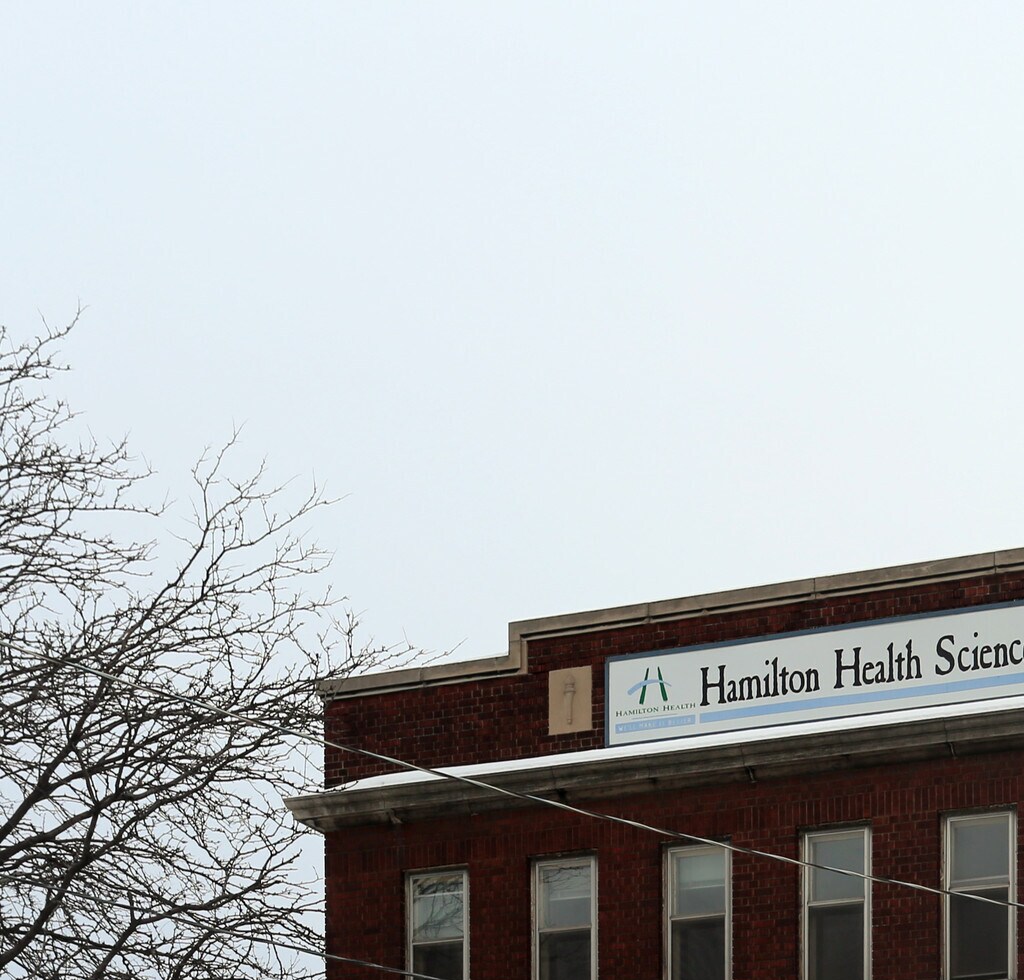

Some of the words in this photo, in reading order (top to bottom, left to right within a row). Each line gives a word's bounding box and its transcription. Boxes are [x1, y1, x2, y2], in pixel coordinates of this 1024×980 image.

[700, 656, 820, 707] Hamilton
[833, 639, 922, 689] Health
[615, 706, 659, 717] HAMILTON
[662, 703, 696, 712] HEALTH
